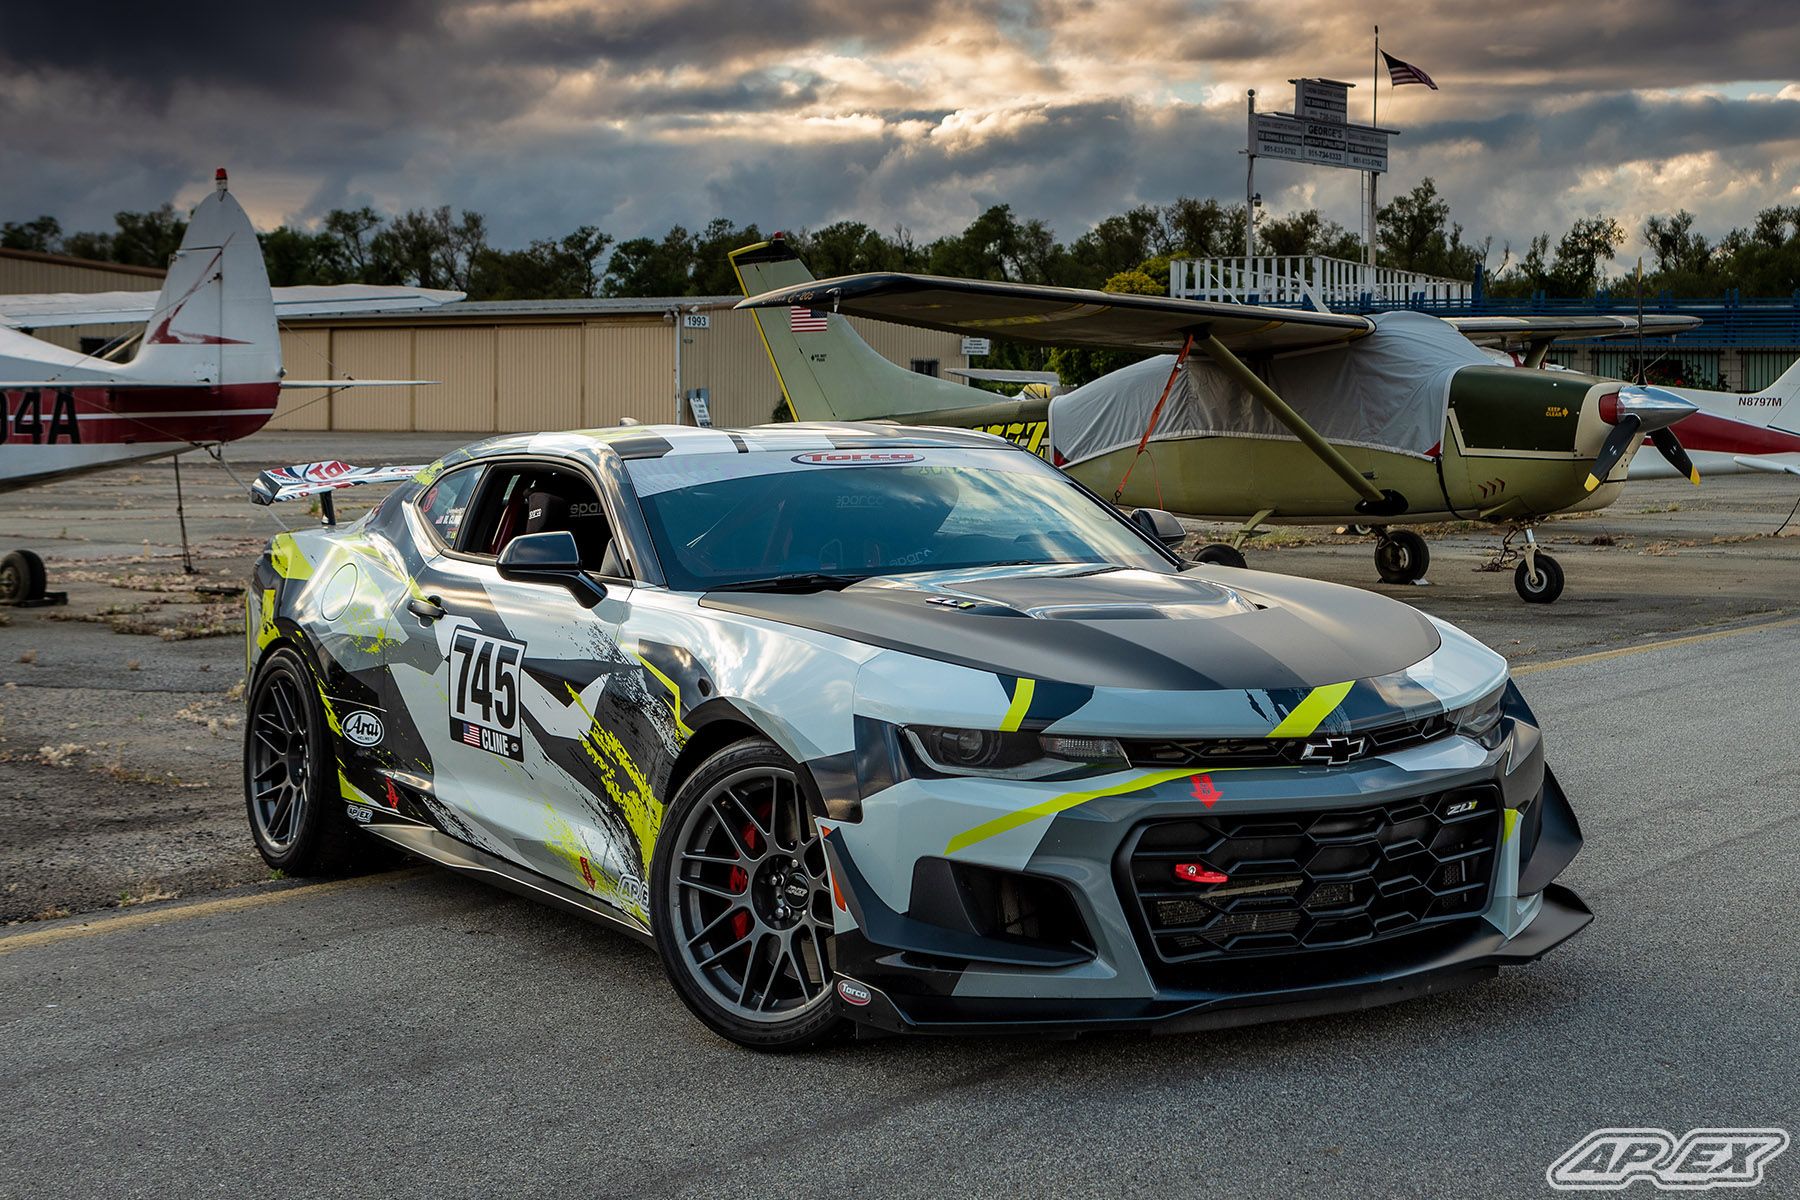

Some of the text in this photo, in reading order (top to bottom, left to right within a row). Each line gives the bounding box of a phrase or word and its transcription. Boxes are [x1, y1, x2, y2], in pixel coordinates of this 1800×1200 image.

[1309, 124, 1342, 139] GEORGE'S
[688, 316, 706, 326] 1993
[1738, 396, 1782, 407] N8797M
[805, 452, 914, 462] Torco
[453, 634, 519, 730] 745
[346, 715, 380, 737] Arai
[481, 728, 509, 756] CLINE
[842, 983, 868, 999] Torco
